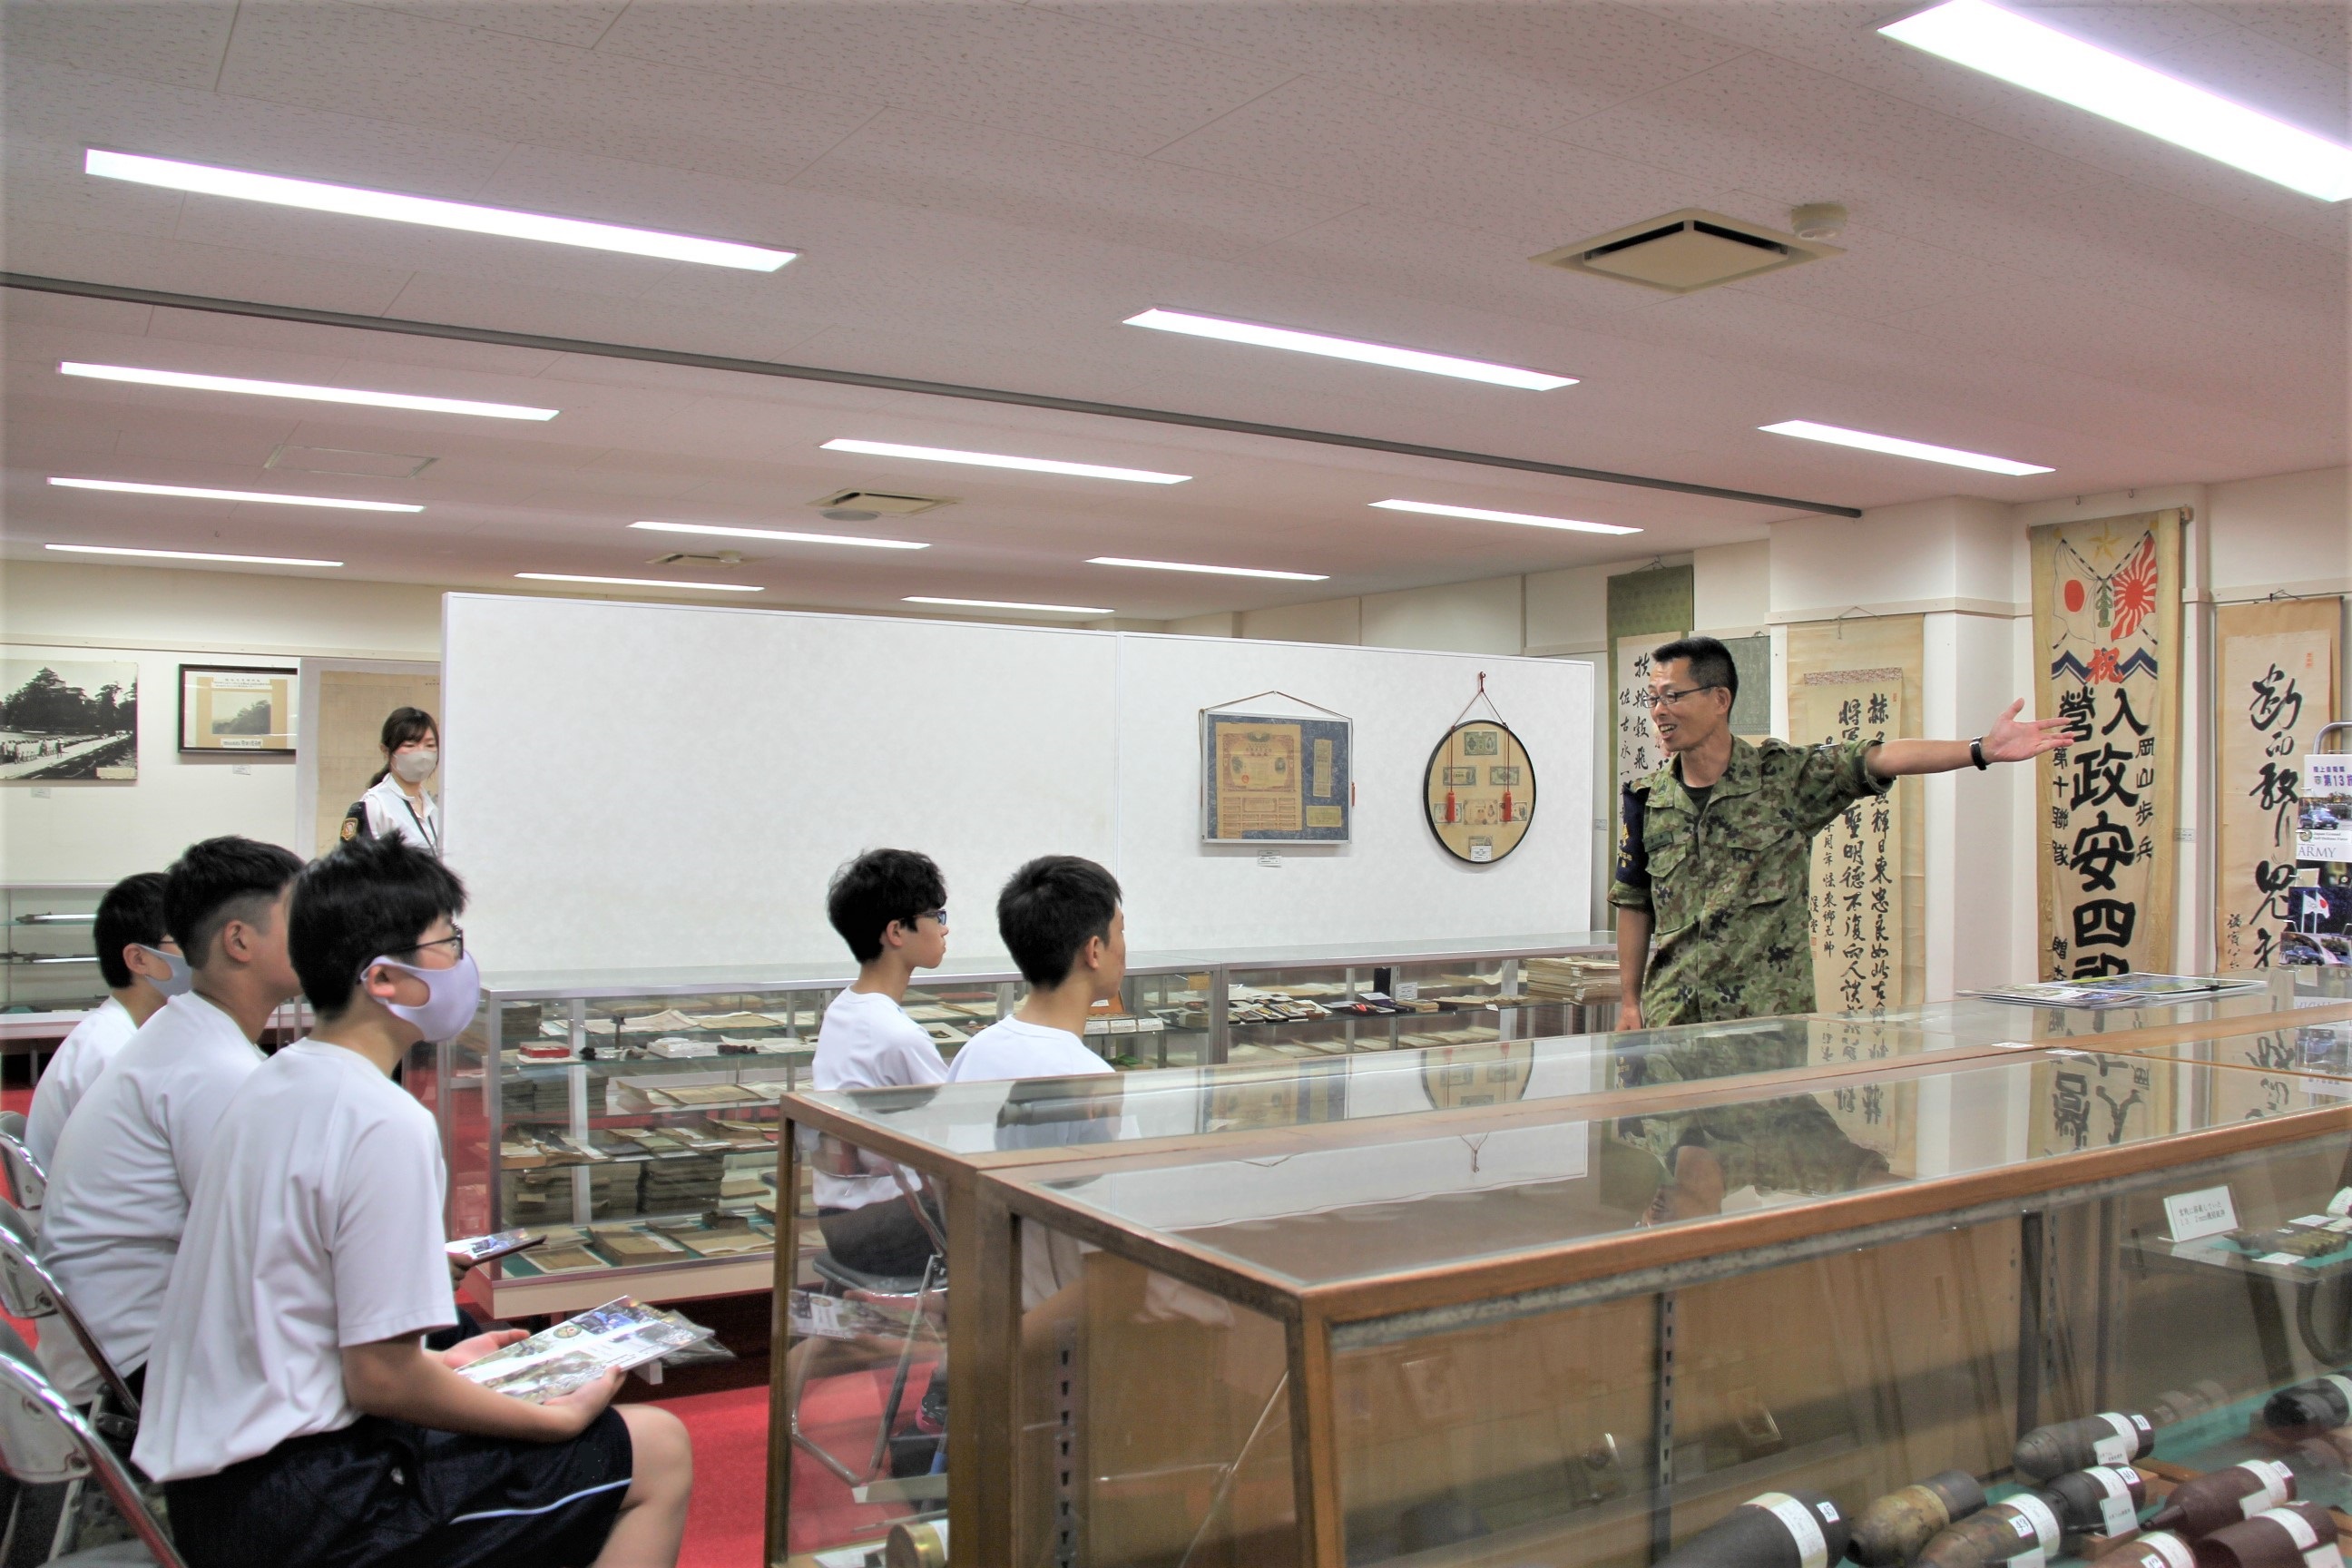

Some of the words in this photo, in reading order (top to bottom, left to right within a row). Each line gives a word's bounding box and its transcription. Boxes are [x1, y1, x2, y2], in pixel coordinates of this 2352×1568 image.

[2086, 647, 2123, 684] 祝
[2135, 736, 2155, 863] 岡山歩兵
[2298, 847, 2337, 858] ARMY
[2122, 1468, 2135, 1481] 40
[1823, 1504, 1836, 1518] 45
[2014, 1518, 2029, 1532] 43
